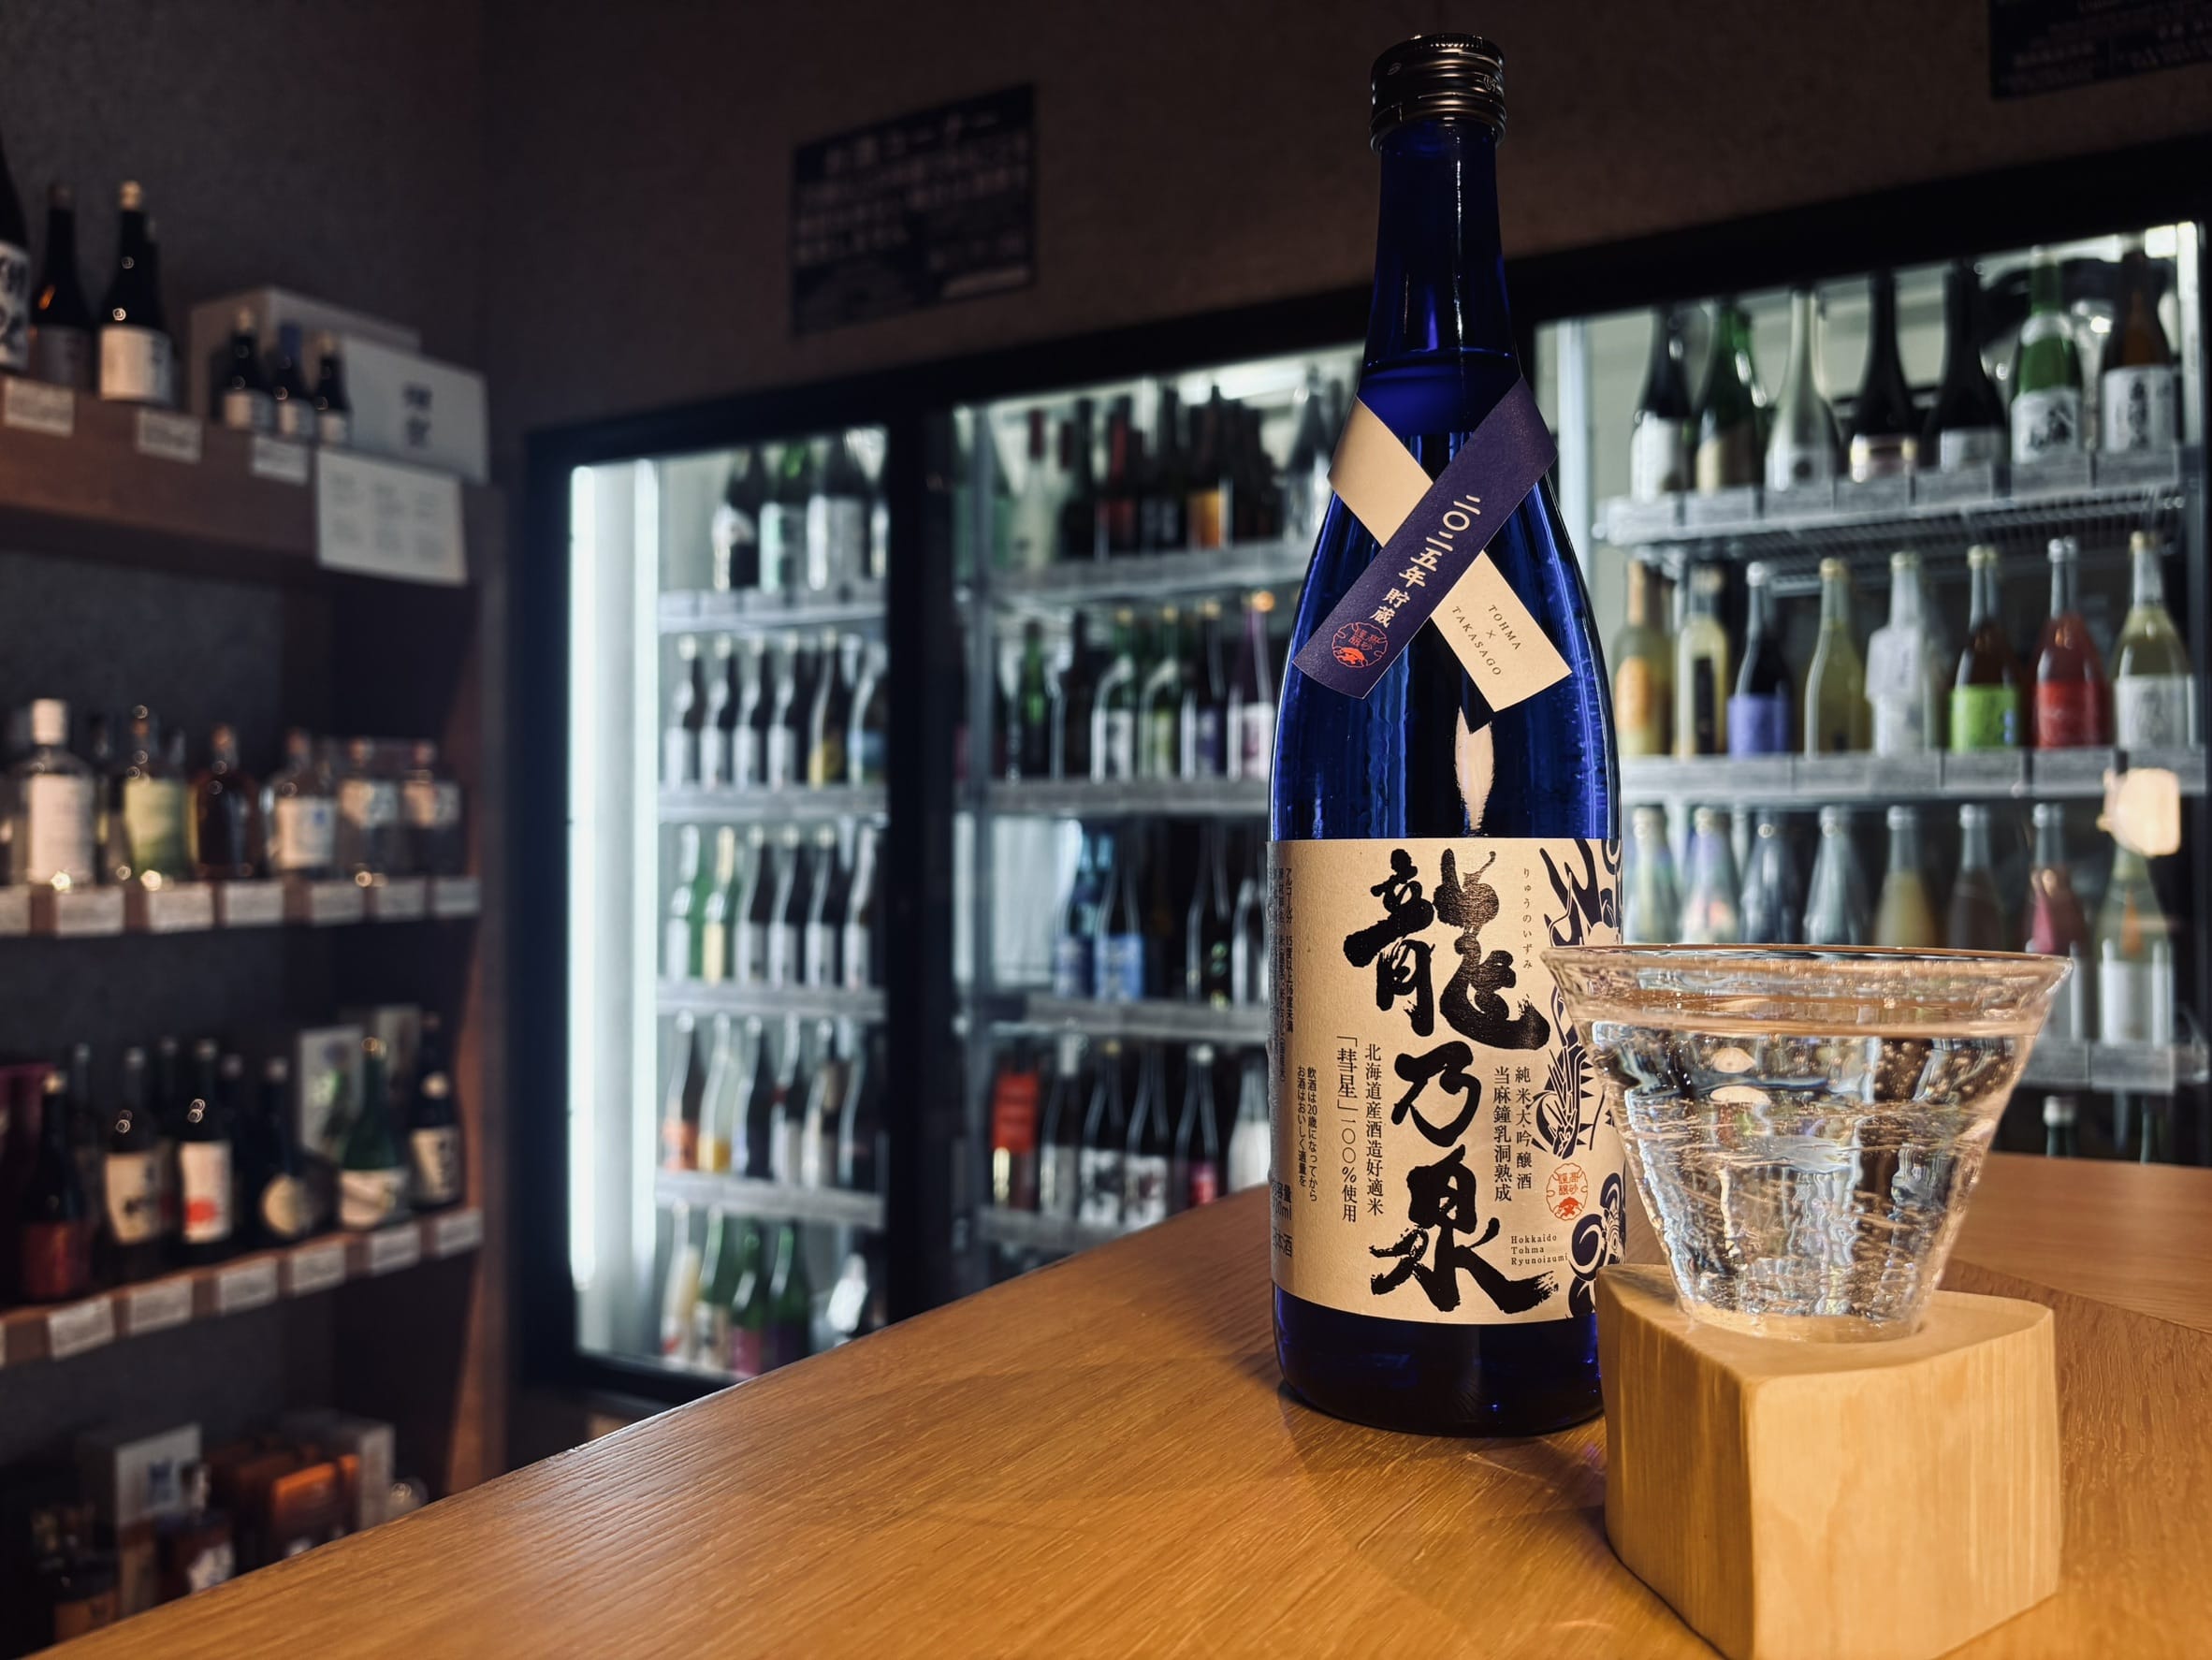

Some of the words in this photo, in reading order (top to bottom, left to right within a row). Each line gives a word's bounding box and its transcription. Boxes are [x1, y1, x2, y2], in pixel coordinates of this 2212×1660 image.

[1369, 494, 1481, 628] 二〇二五年貯蔵
[1452, 606, 1502, 675] TAKASAGO
[1488, 604, 1521, 650] TOHMA
[1522, 867, 1533, 969] りゅうのいずみ
[1297, 1065, 1307, 1187] お酒はおいしく適量を
[1307, 1067, 1318, 1201] 飲酒は20歳になってから
[1365, 1043, 1384, 1216] 北海道産酒造好適米
[1493, 1066, 1513, 1202] 当麻鐘乳洞熟成
[1515, 1066, 1533, 1190] 純米大吟醸酒
[1511, 1233, 1557, 1245] Hokkaido
[1511, 1245, 1545, 1255] Tohma
[1511, 1253, 1568, 1266] Ryunoizumi
